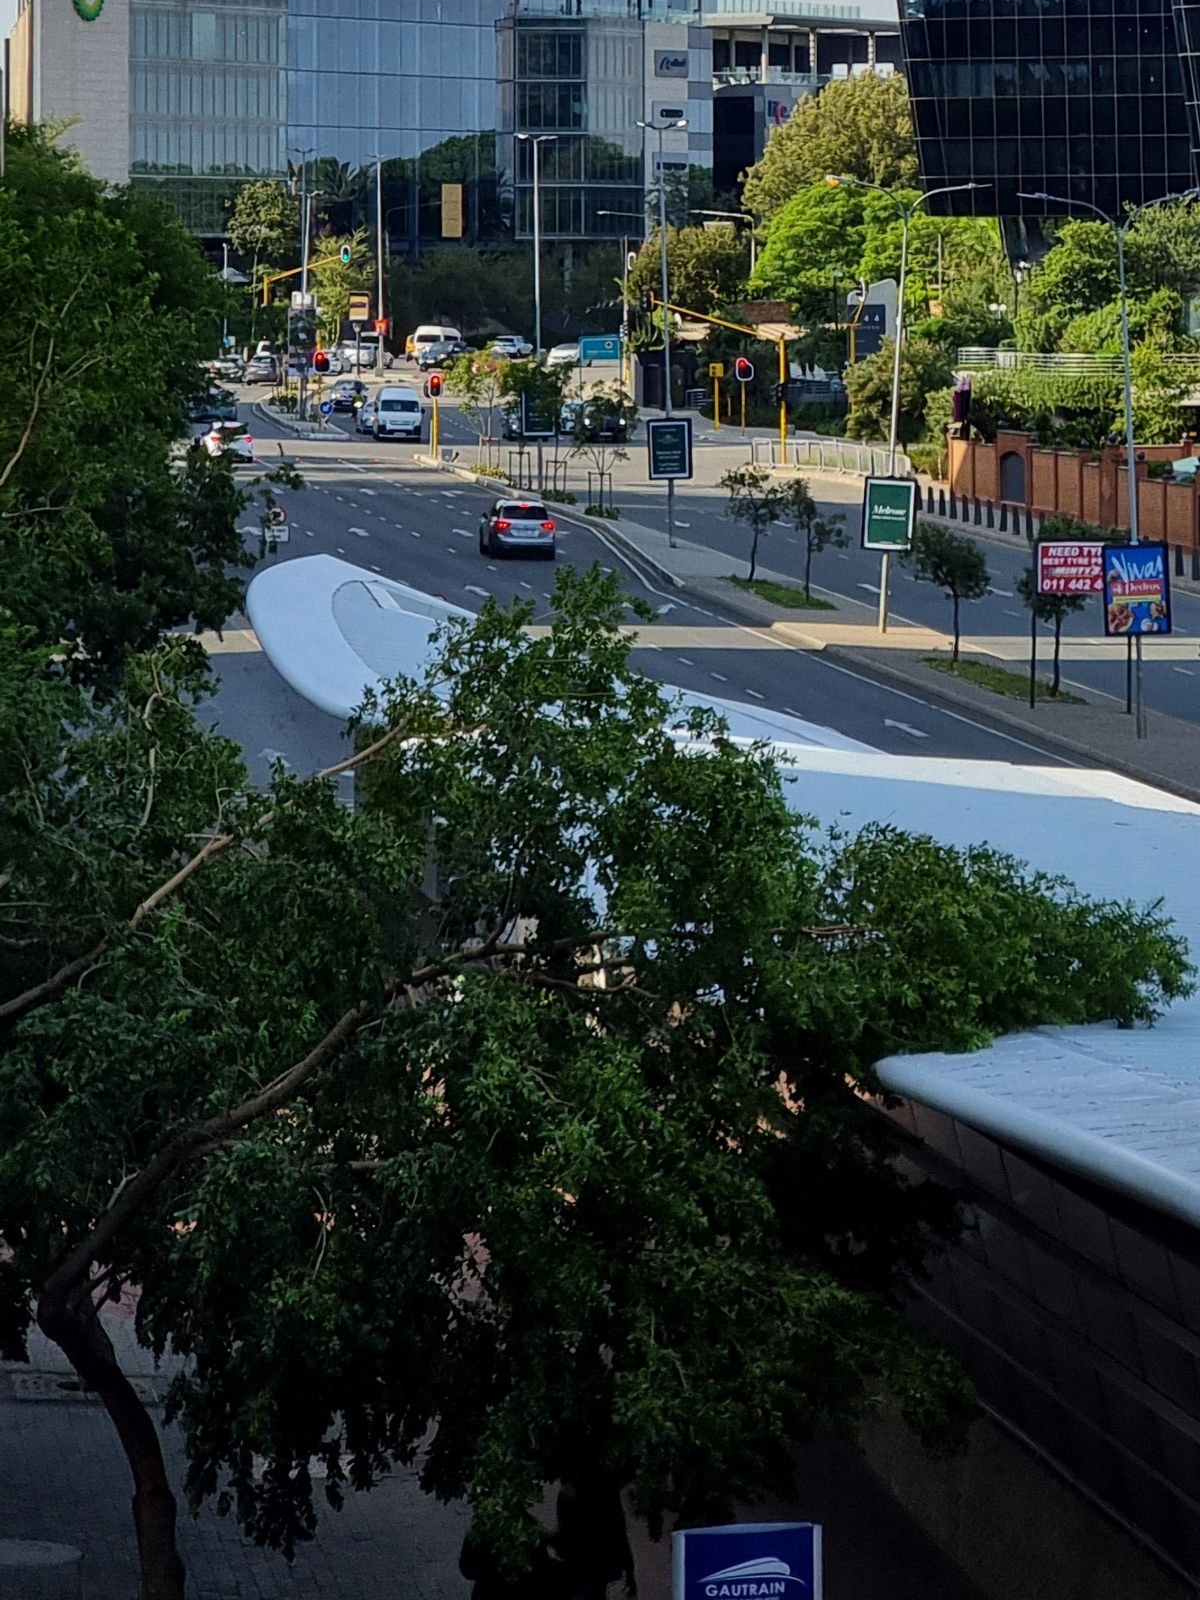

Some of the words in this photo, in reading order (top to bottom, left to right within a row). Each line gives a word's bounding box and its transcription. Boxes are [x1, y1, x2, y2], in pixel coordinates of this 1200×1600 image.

[1048, 547, 1079, 557] NEED
[1042, 557, 1064, 566] BEST
[1067, 557, 1089, 566] TYRE
[1112, 553, 1164, 583] Viva!
[1042, 579, 1065, 591] 011
[1068, 579, 1092, 591] 442
[705, 1581, 785, 1597] GAUTRAIN
